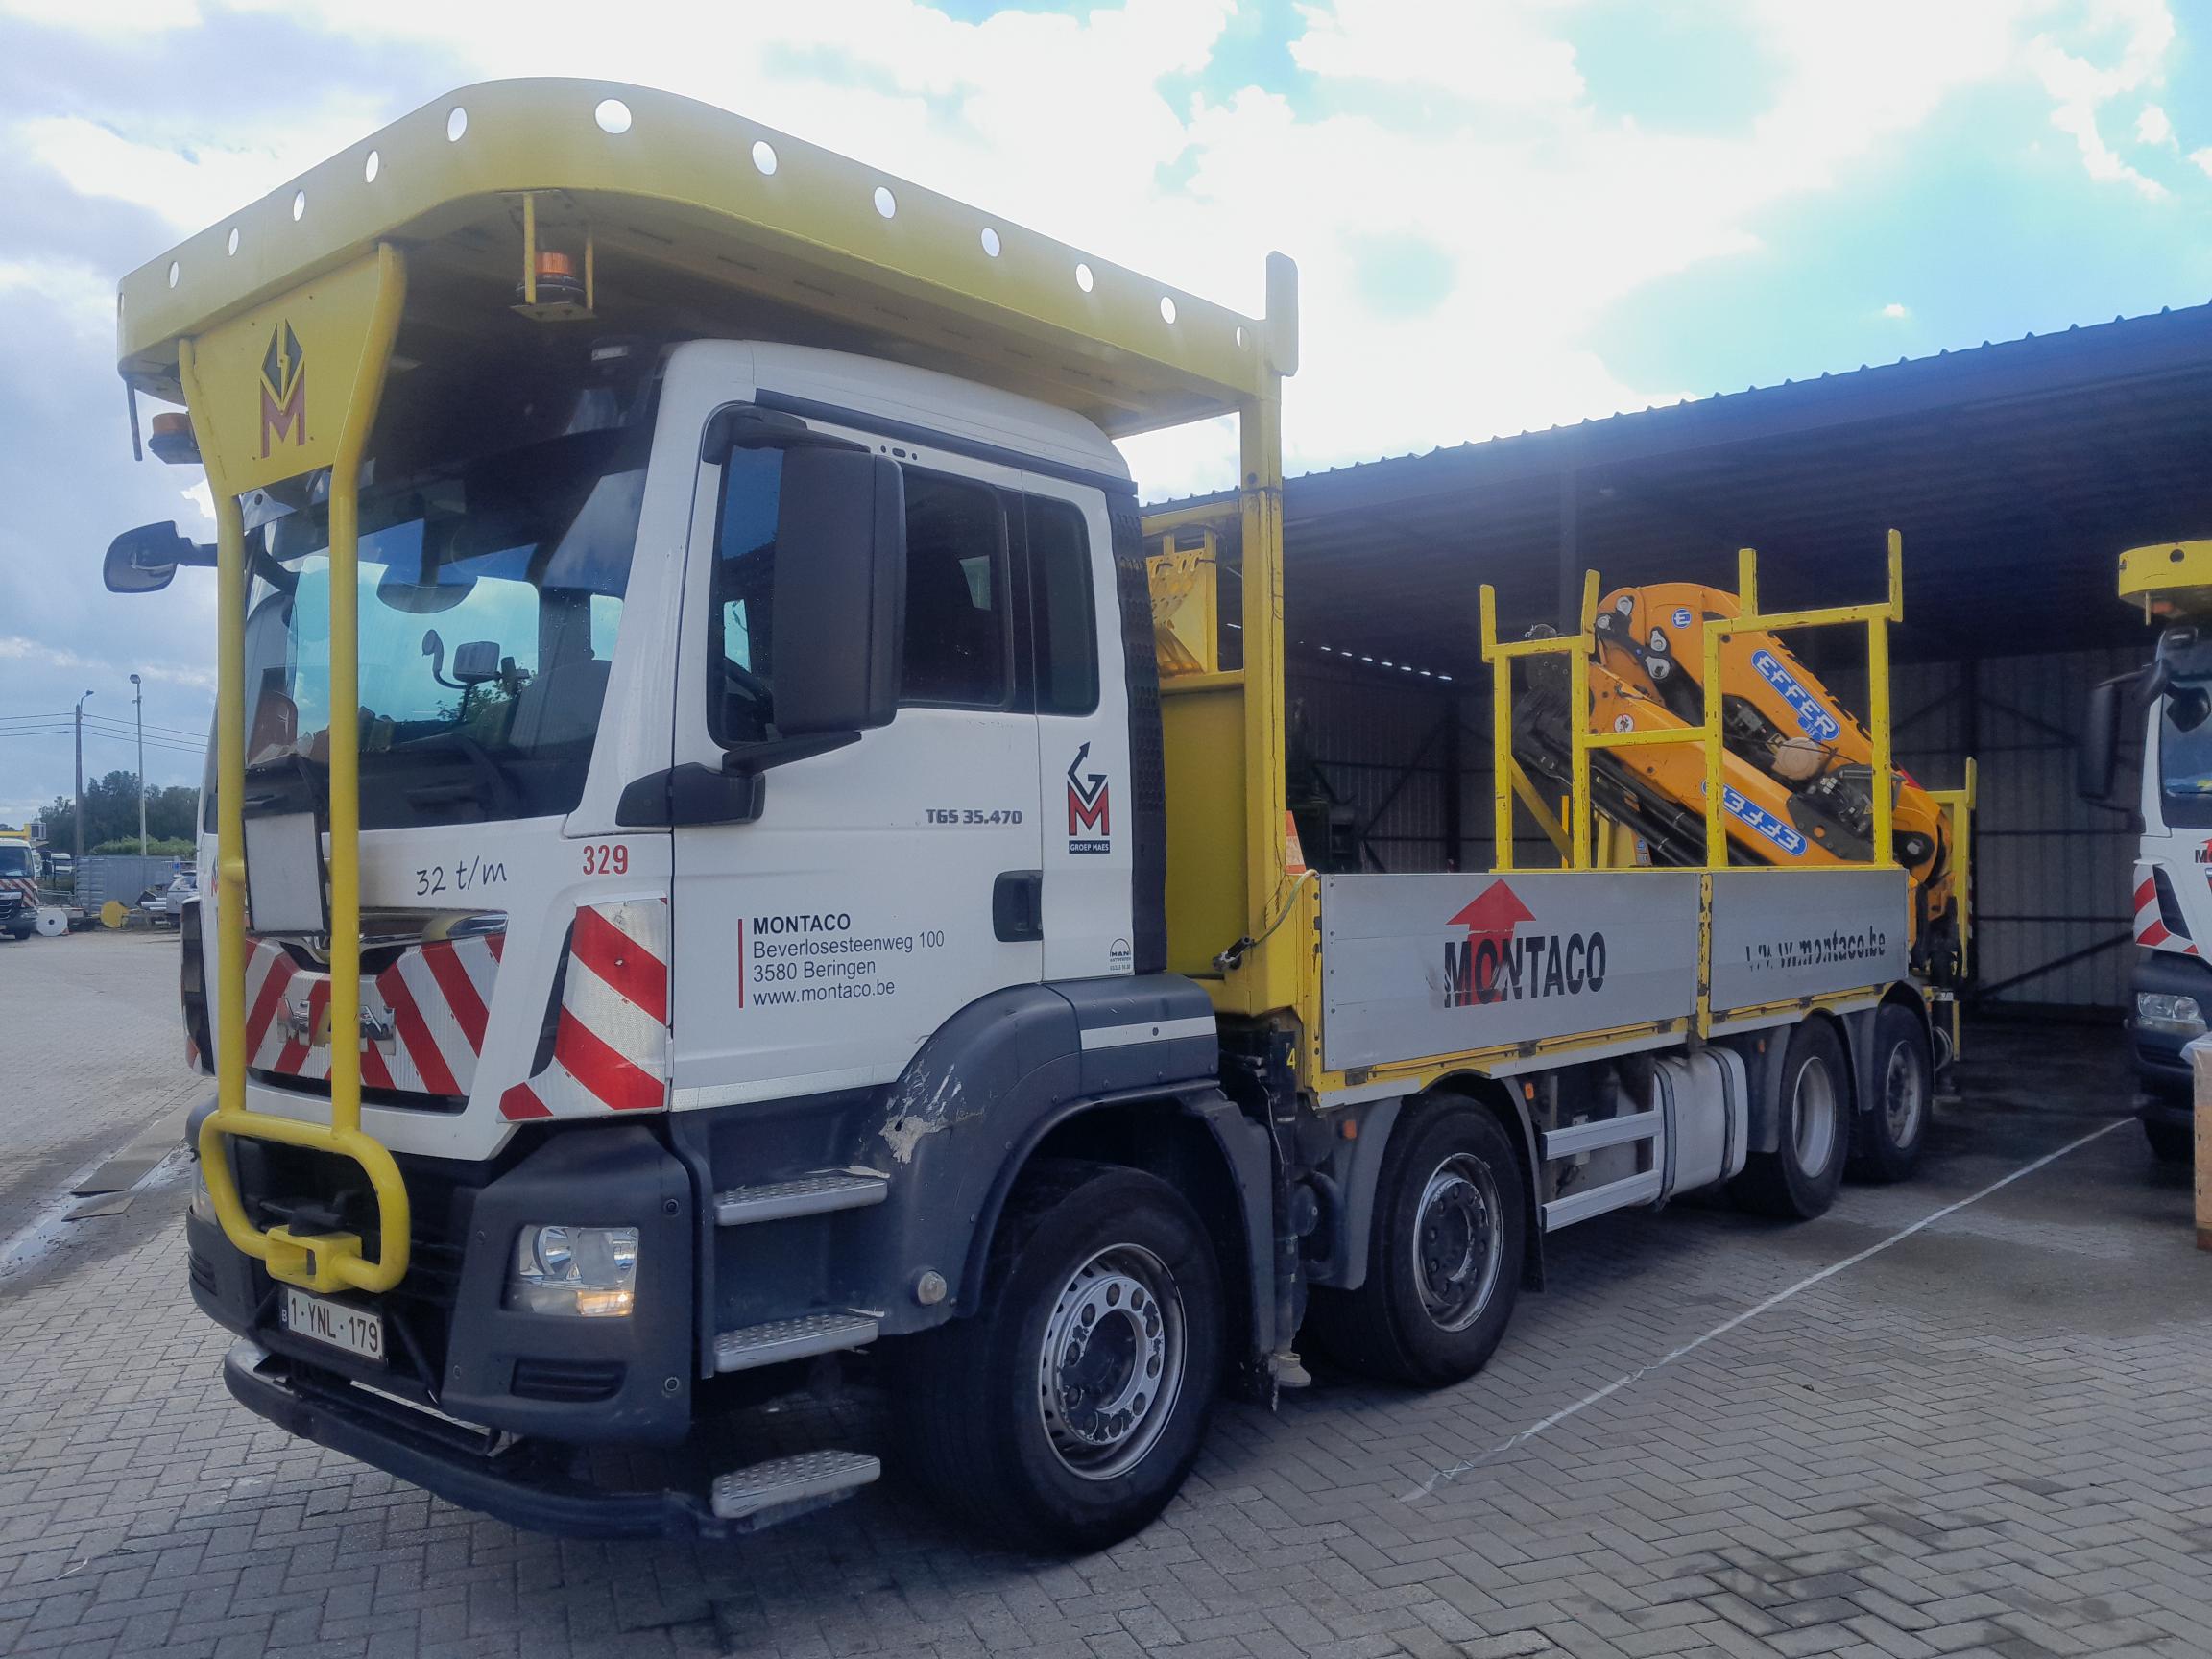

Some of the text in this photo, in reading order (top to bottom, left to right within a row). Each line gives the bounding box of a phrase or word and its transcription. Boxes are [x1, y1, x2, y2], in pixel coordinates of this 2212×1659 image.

[1756, 655, 1838, 737] EFFER
[926, 809, 1022, 825] TGS 35.470
[1723, 786, 1801, 851] EFFE
[583, 844, 629, 876] 329
[417, 854, 508, 897] 32 t/m
[753, 913, 851, 935] MONTACO
[754, 930, 945, 959] Beverlosesteenweg 100
[753, 959, 876, 983] 3580 Beringen
[1444, 931, 1606, 1009] MONTACO
[753, 978, 895, 1006] www.montaco.be
[281, 1309, 288, 1322] B
